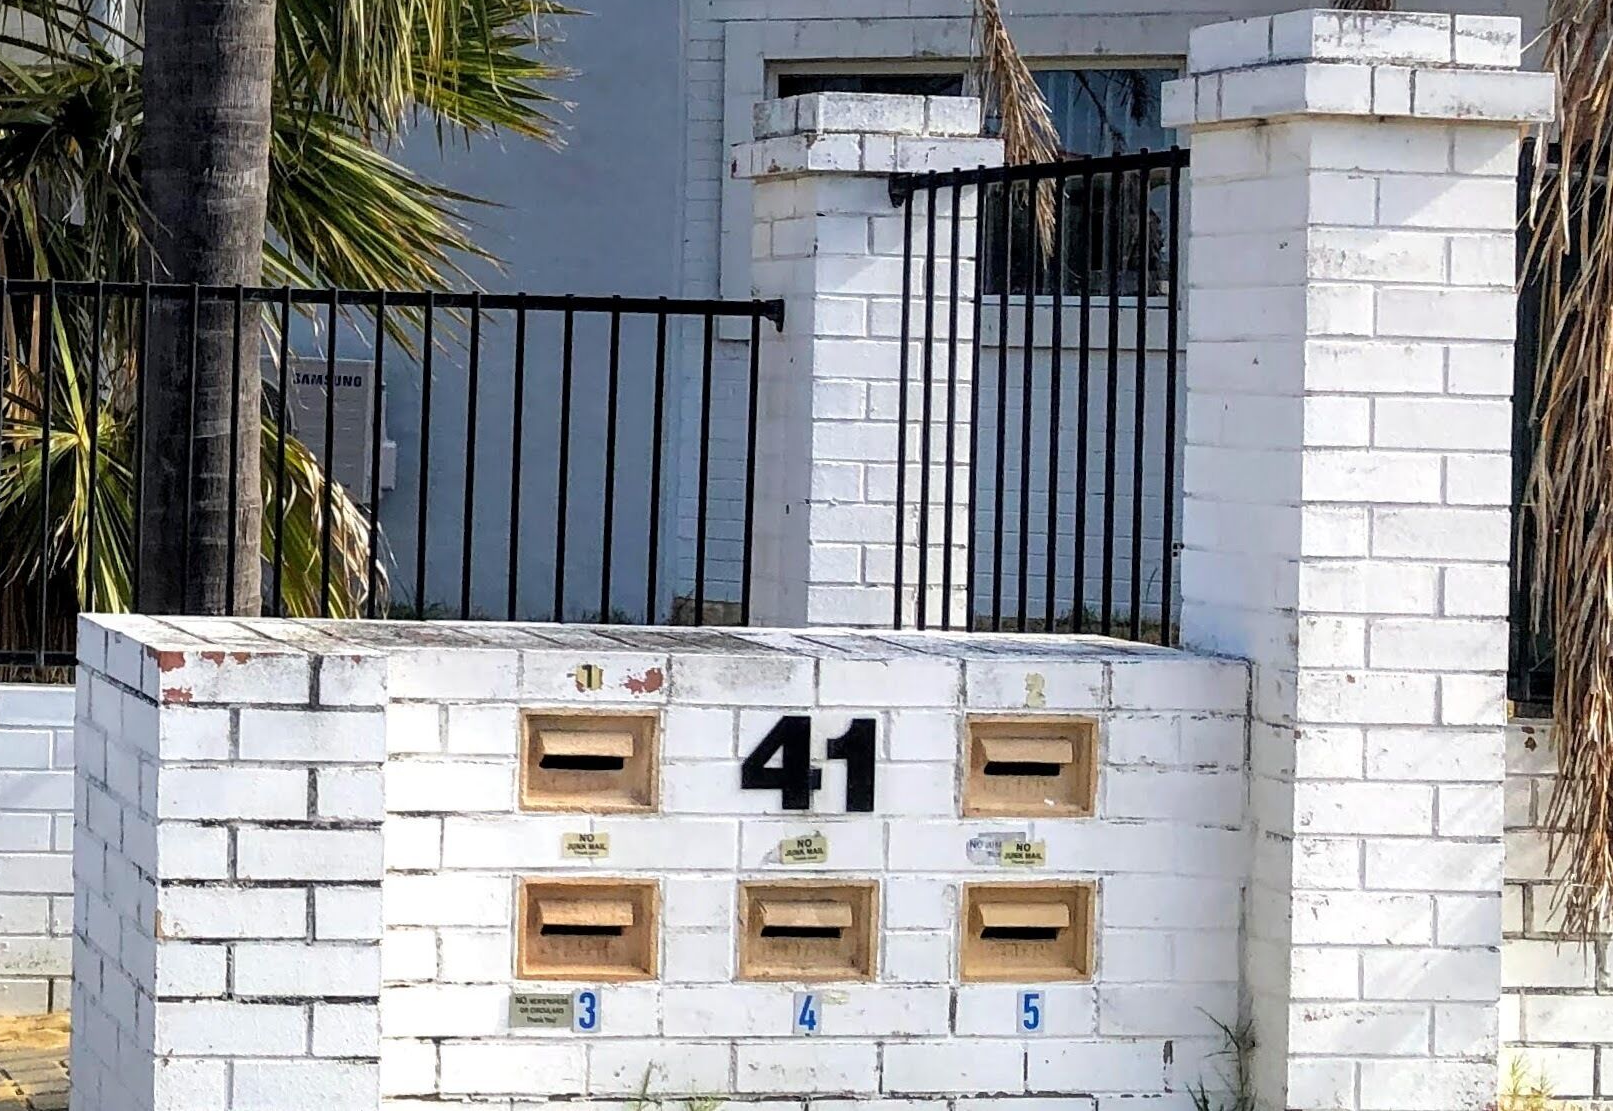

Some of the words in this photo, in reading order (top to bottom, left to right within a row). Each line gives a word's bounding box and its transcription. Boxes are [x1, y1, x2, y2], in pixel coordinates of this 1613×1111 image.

[740, 716, 876, 812] 41
[579, 833, 595, 842] NO
[797, 839, 812, 848] NO
[1016, 843, 1031, 852] NO
[515, 996, 528, 1004] NO
[579, 992, 596, 1029] 3
[799, 995, 817, 1030] 4
[1023, 994, 1040, 1029] 5
